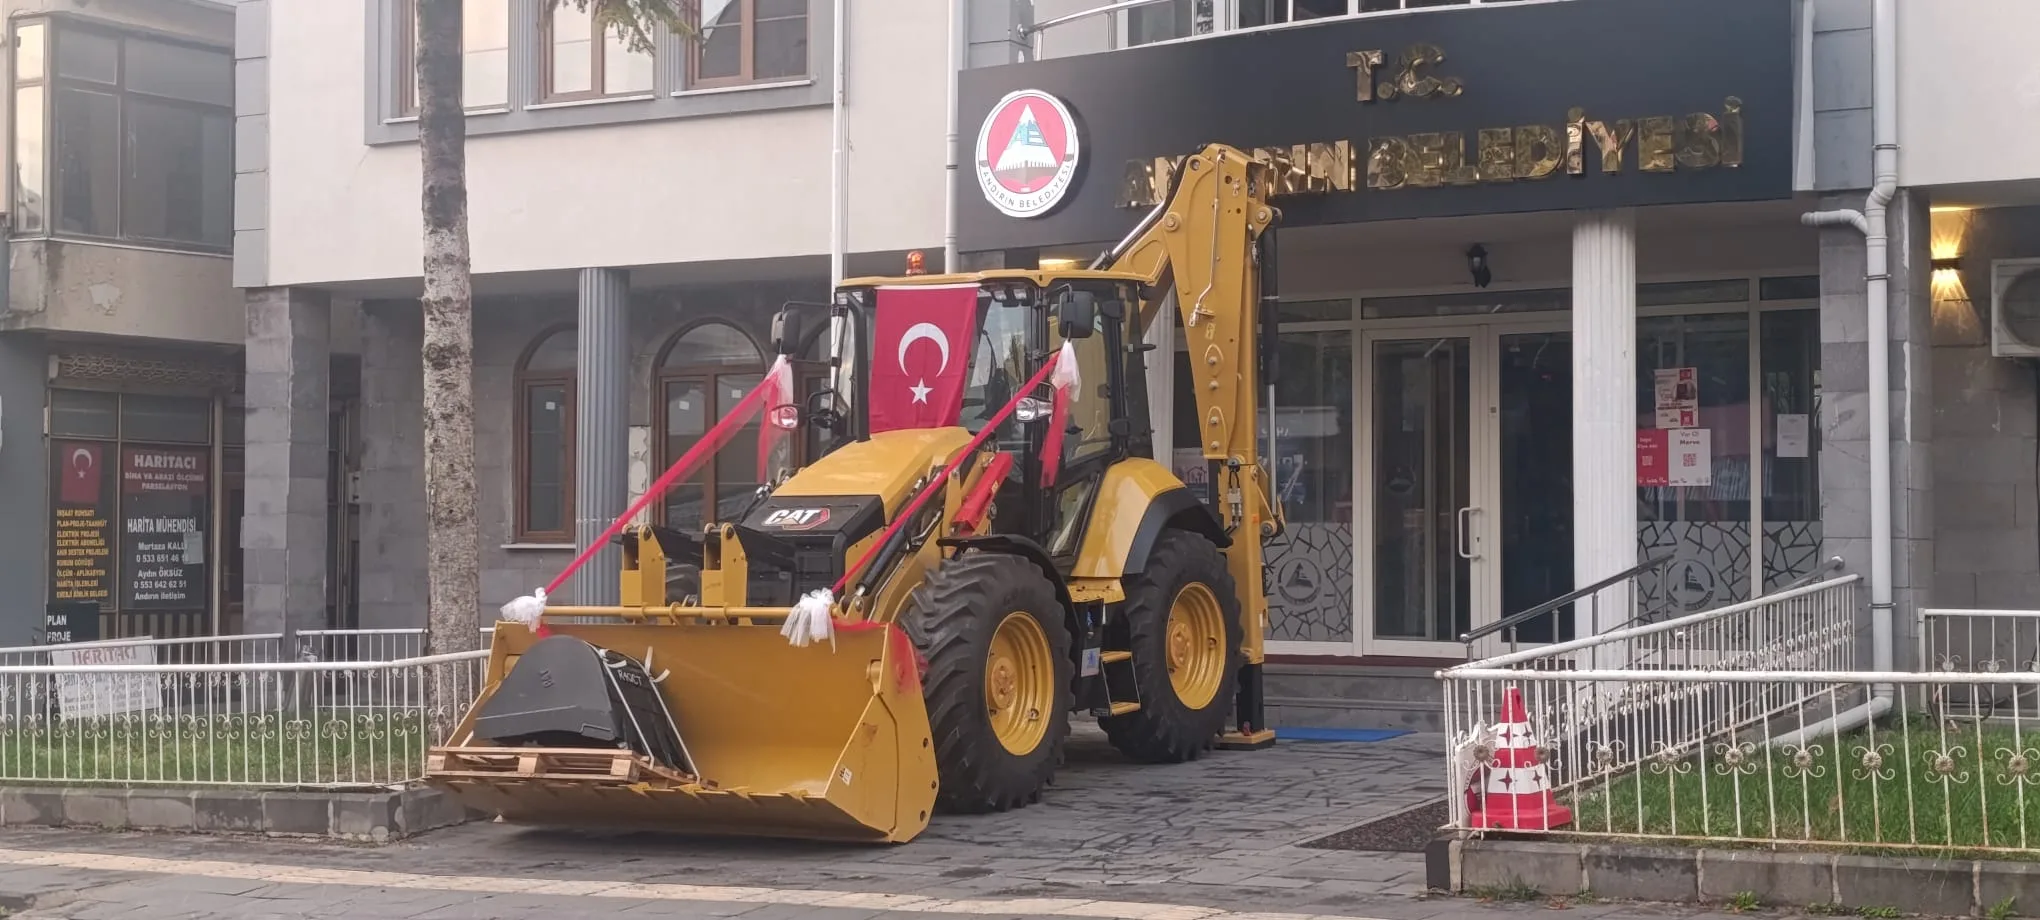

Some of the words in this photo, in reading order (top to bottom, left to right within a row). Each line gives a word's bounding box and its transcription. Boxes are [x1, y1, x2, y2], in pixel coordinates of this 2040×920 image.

[1346, 43, 1463, 101] T.C.
[1367, 96, 1743, 190] BELEDİYESİ
[983, 171, 1015, 206] ANDIRIN
[134, 453, 196, 469] HARİTACI
[764, 509, 822, 525] CAT
[127, 516, 154, 533] HARİTA
[155, 516, 196, 533] MÜHENDİSİ
[138, 542, 166, 550] Murtaza
[143, 554, 155, 563] 533
[138, 570, 157, 579] Aydın
[159, 566, 183, 577] ÖKSÜZ
[140, 581, 153, 589] 553
[154, 581, 167, 589] 642
[47, 615, 67, 626] PLAN
[47, 631, 72, 643] PROJE
